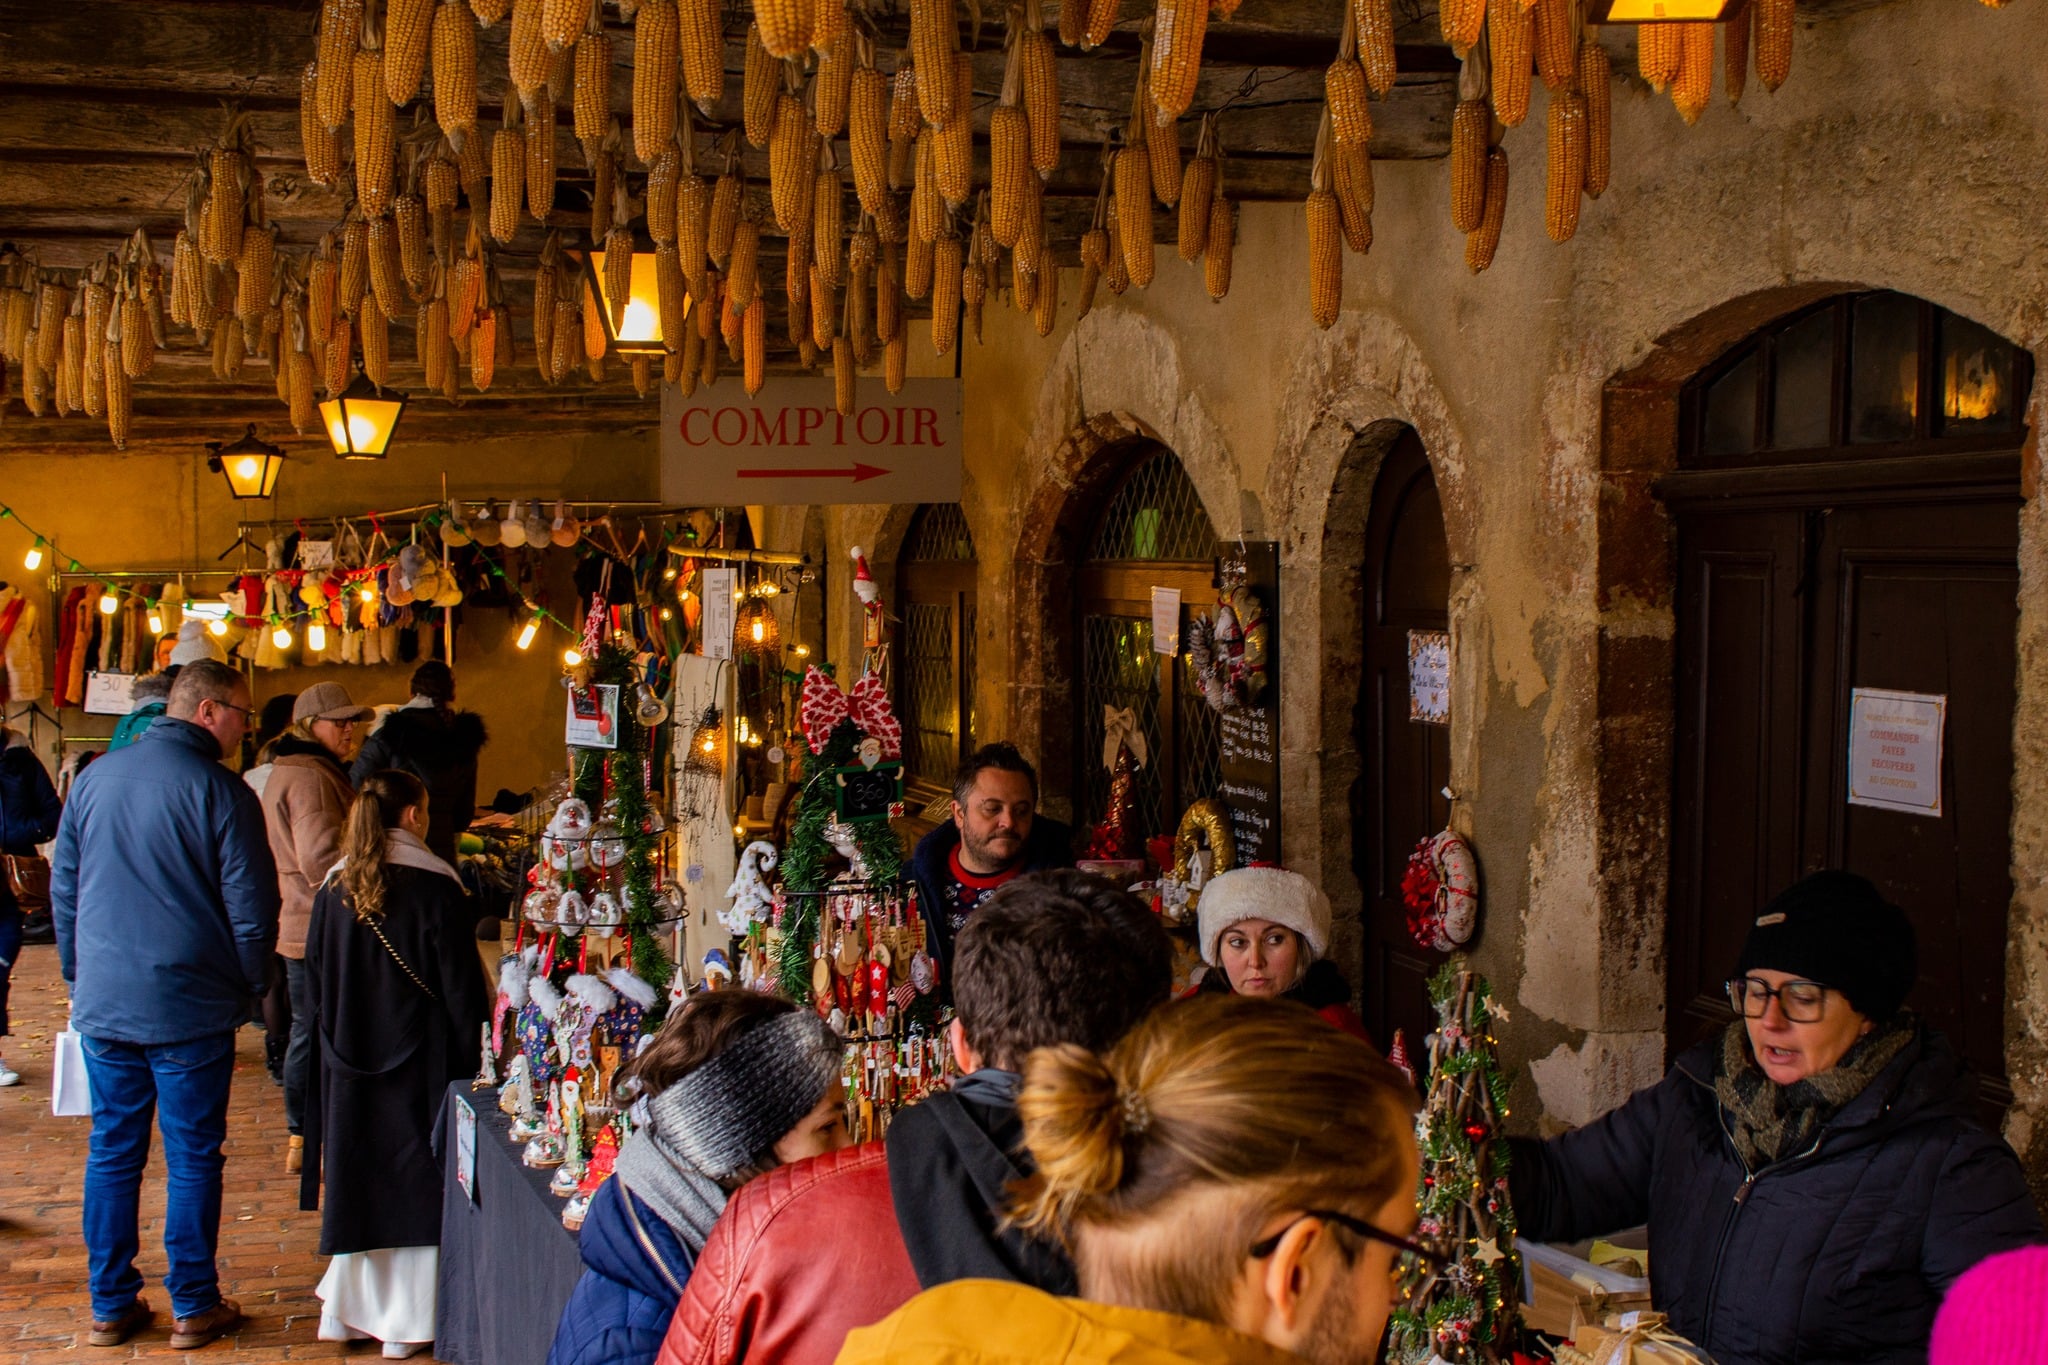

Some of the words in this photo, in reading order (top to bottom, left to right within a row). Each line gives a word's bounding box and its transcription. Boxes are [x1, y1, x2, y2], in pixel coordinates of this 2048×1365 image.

[680, 406, 946, 447] COMPTOIR
[1870, 729, 1920, 743] COMMANDER
[1881, 745, 1905, 756] PAYER
[925, 796, 953, 818] CAF
